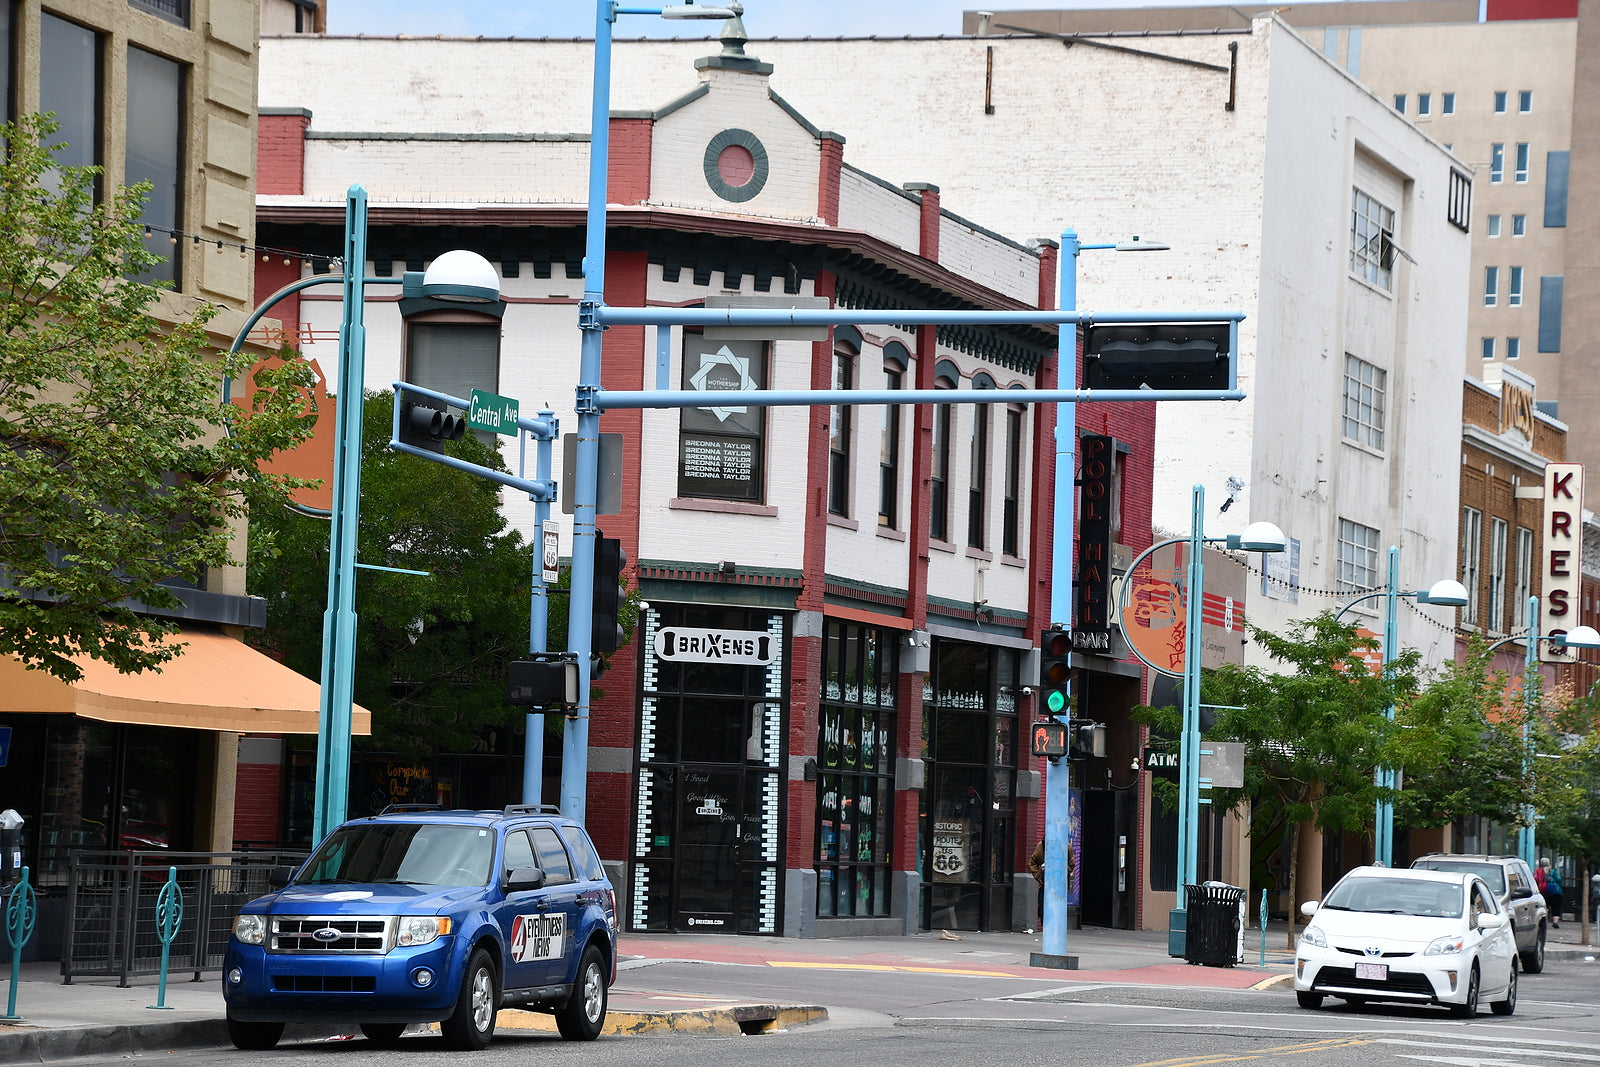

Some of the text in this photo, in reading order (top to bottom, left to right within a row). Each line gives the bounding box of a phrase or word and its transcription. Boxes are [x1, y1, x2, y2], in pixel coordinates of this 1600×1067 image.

[471, 395, 518, 428] Central Ave
[1502, 381, 1534, 441] KRESS
[1084, 439, 1105, 624] POOL HALL
[546, 551, 556, 565] 66
[679, 633, 754, 658] BRIXENS
[1074, 631, 1109, 649] BAR
[1148, 752, 1178, 766] ATM
[936, 836, 959, 844] ROUTE
[936, 854, 961, 871] 66
[528, 916, 562, 938] EYEWITNESS
[533, 937, 551, 957] NEWS
